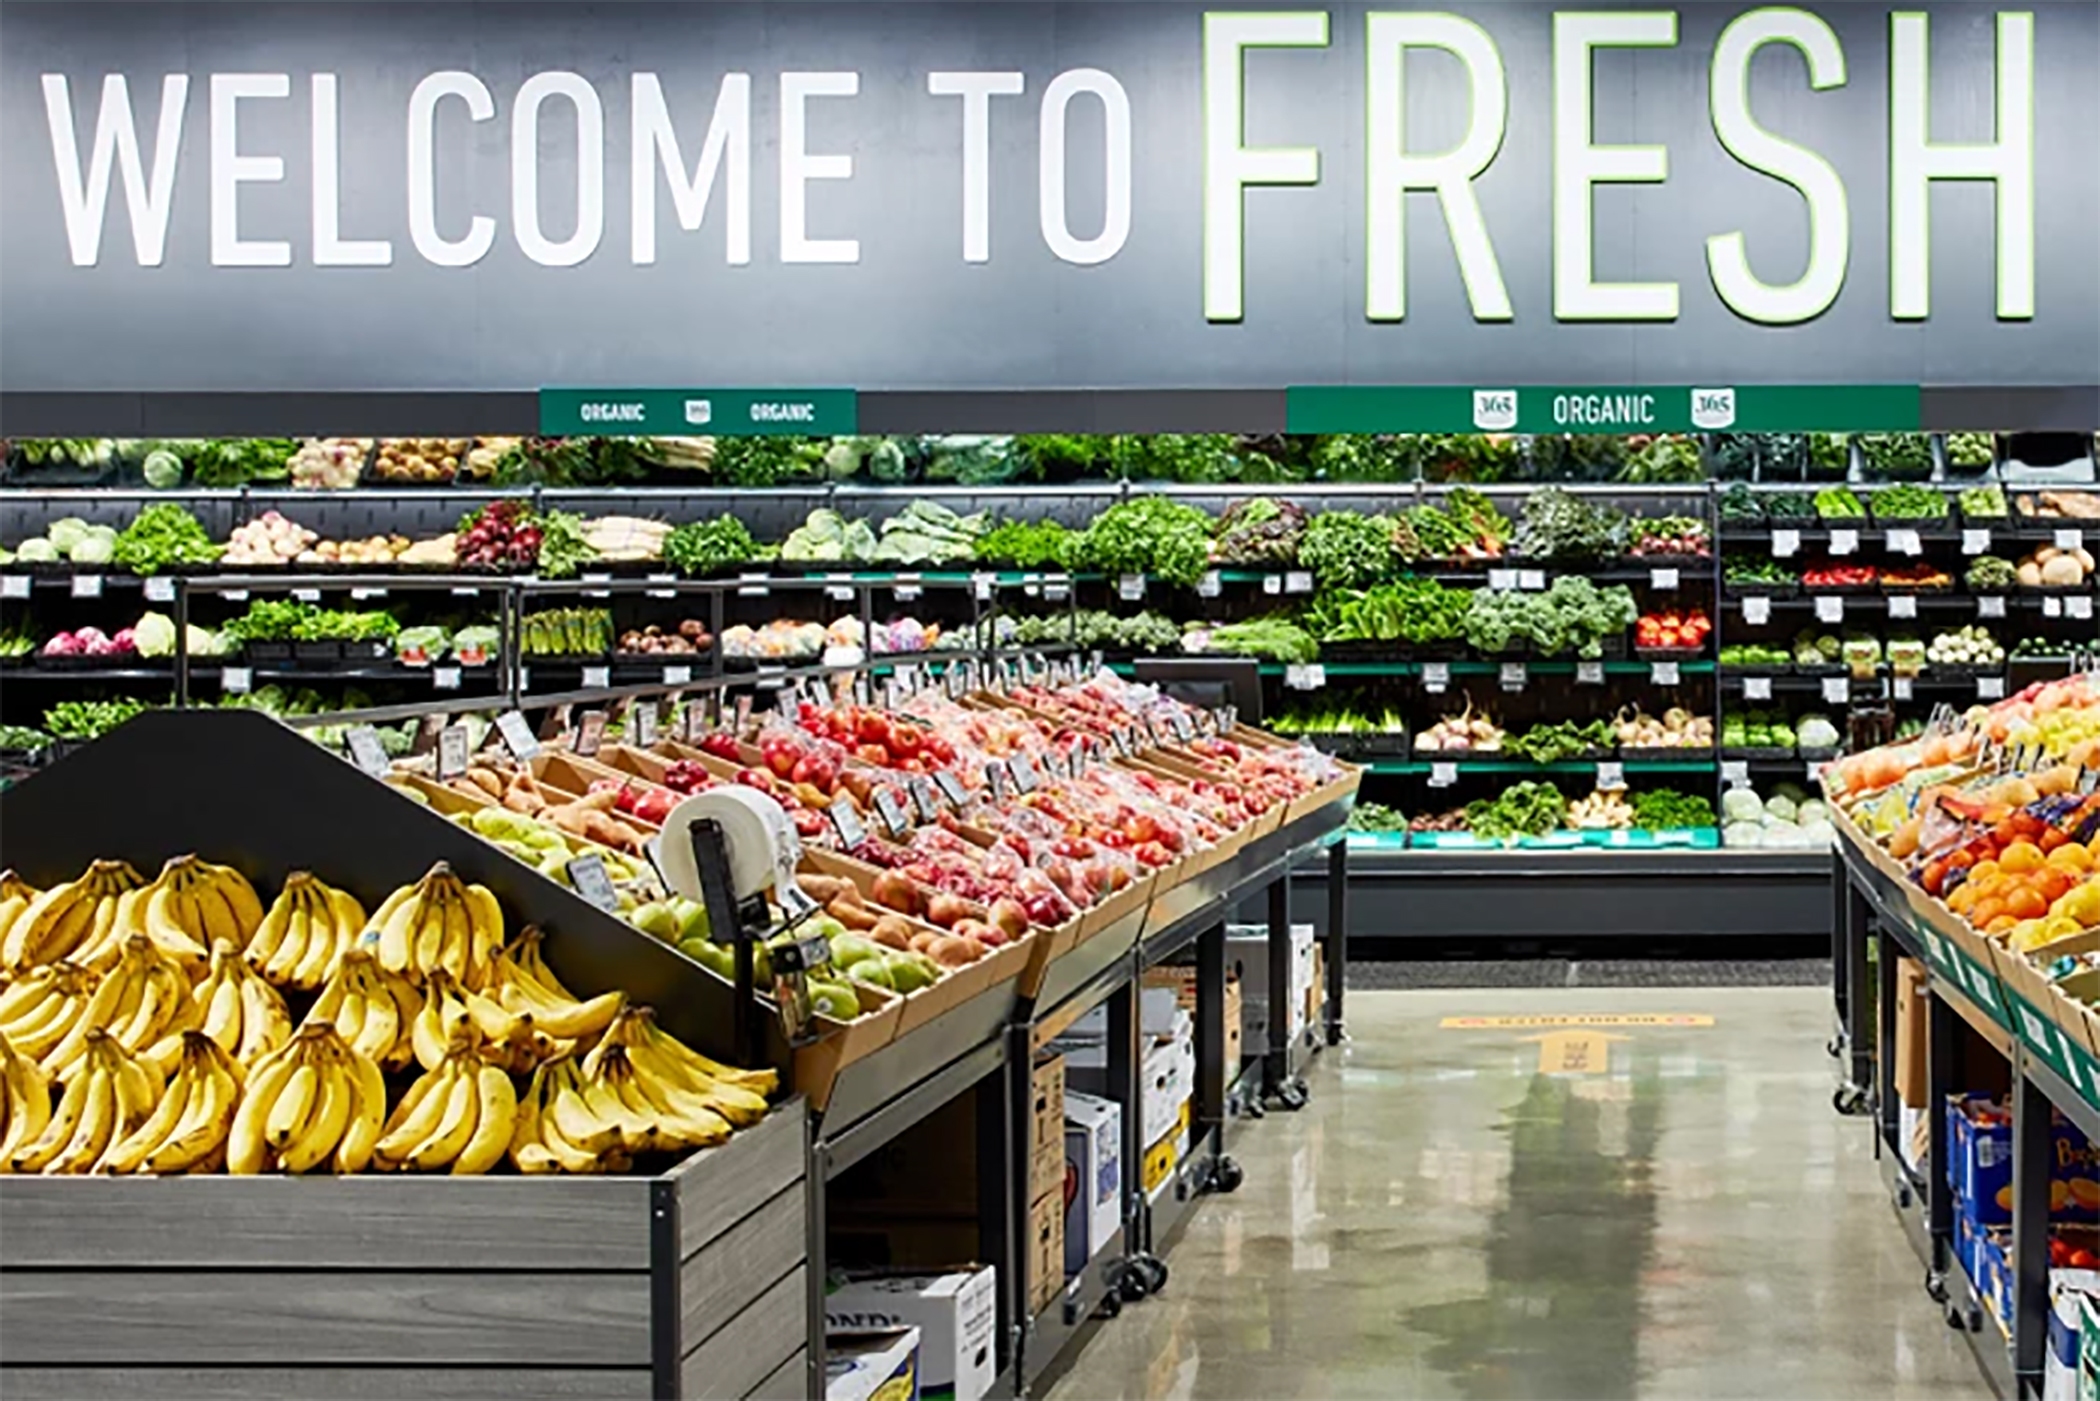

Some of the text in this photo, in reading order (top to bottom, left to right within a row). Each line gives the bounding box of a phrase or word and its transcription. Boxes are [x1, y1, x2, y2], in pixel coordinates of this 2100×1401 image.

[42, 7, 2035, 324] WELCOME TO FRESH
[581, 403, 814, 421] ORGANIC ORGANIC
[1478, 394, 1730, 424] 365 ORGANIC 365
